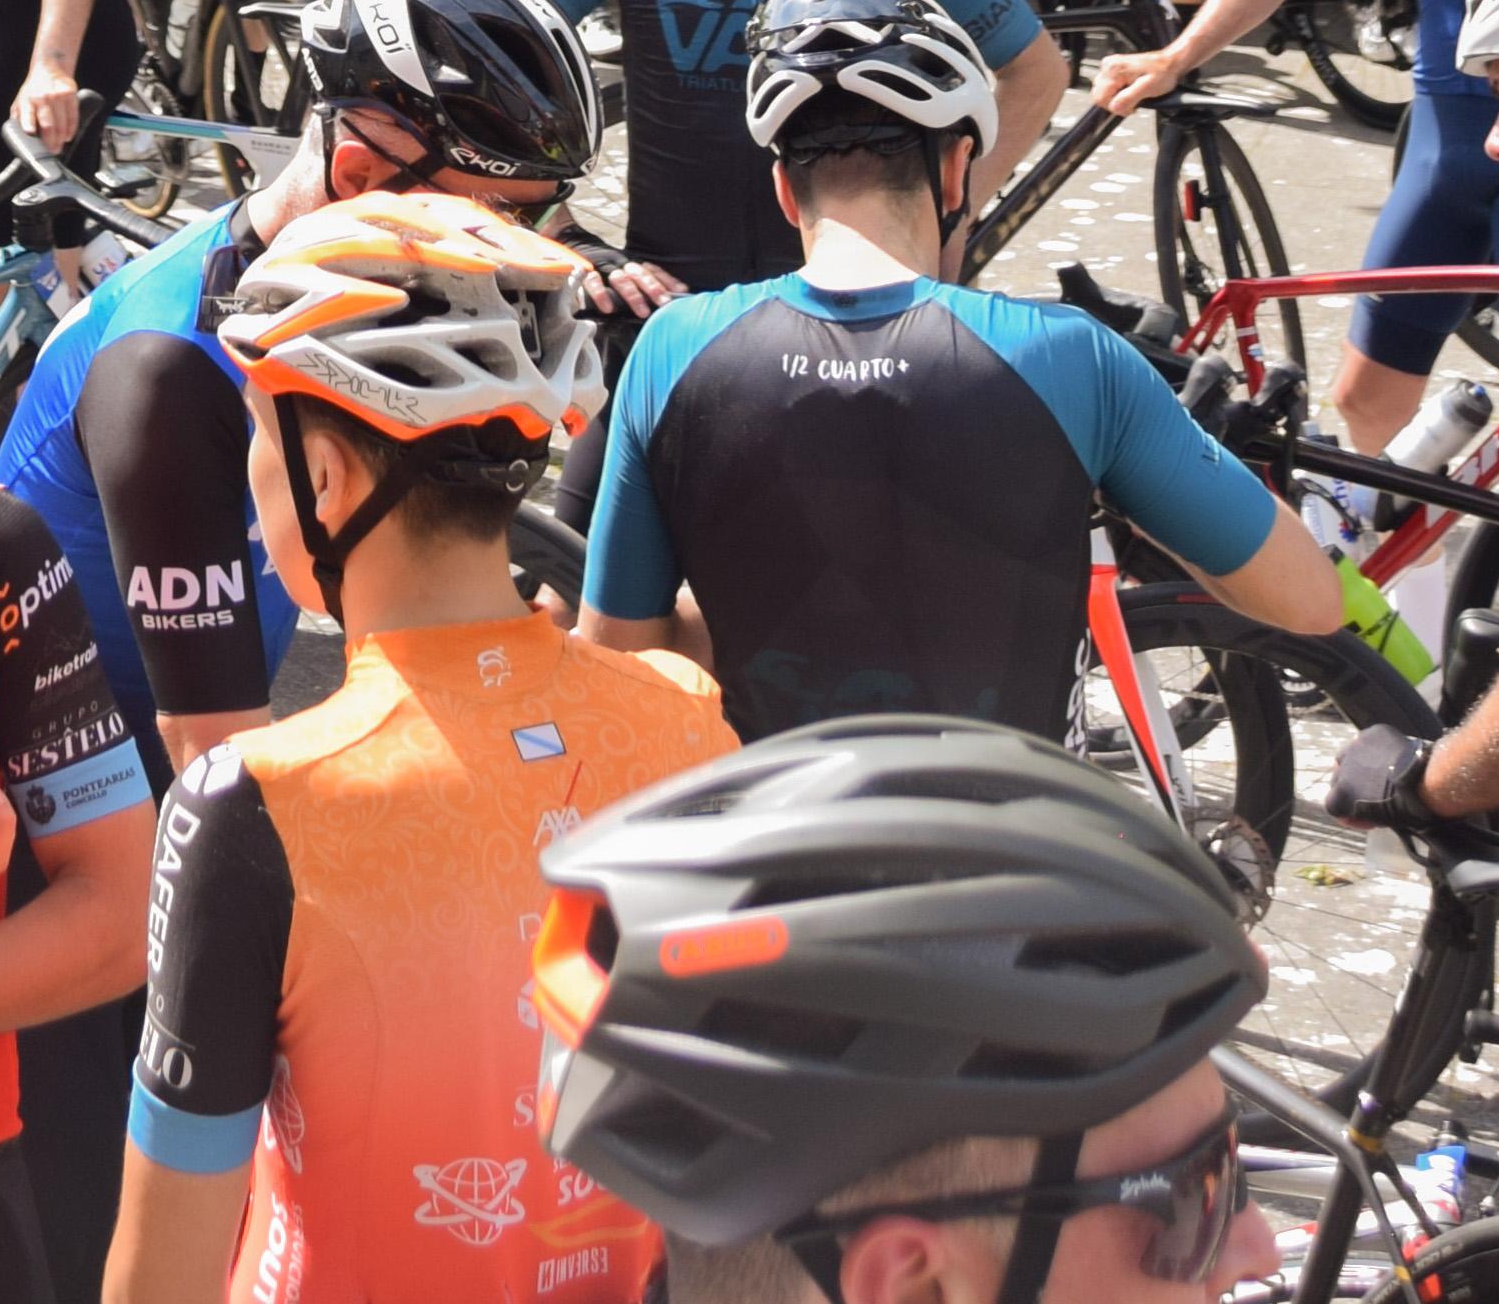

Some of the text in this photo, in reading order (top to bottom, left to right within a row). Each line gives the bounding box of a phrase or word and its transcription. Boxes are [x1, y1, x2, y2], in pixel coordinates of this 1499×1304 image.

[677, 73, 749, 91] TRIATL
[781, 353, 810, 377] 1/2
[126, 558, 247, 610] ADN
[141, 608, 236, 630] BIKERS
[31, 699, 100, 741] GRUPO
[62, 766, 137, 802] PONTEAREAS
[65, 790, 108, 809] CONCELLO
[146, 812, 202, 976] DAFER
